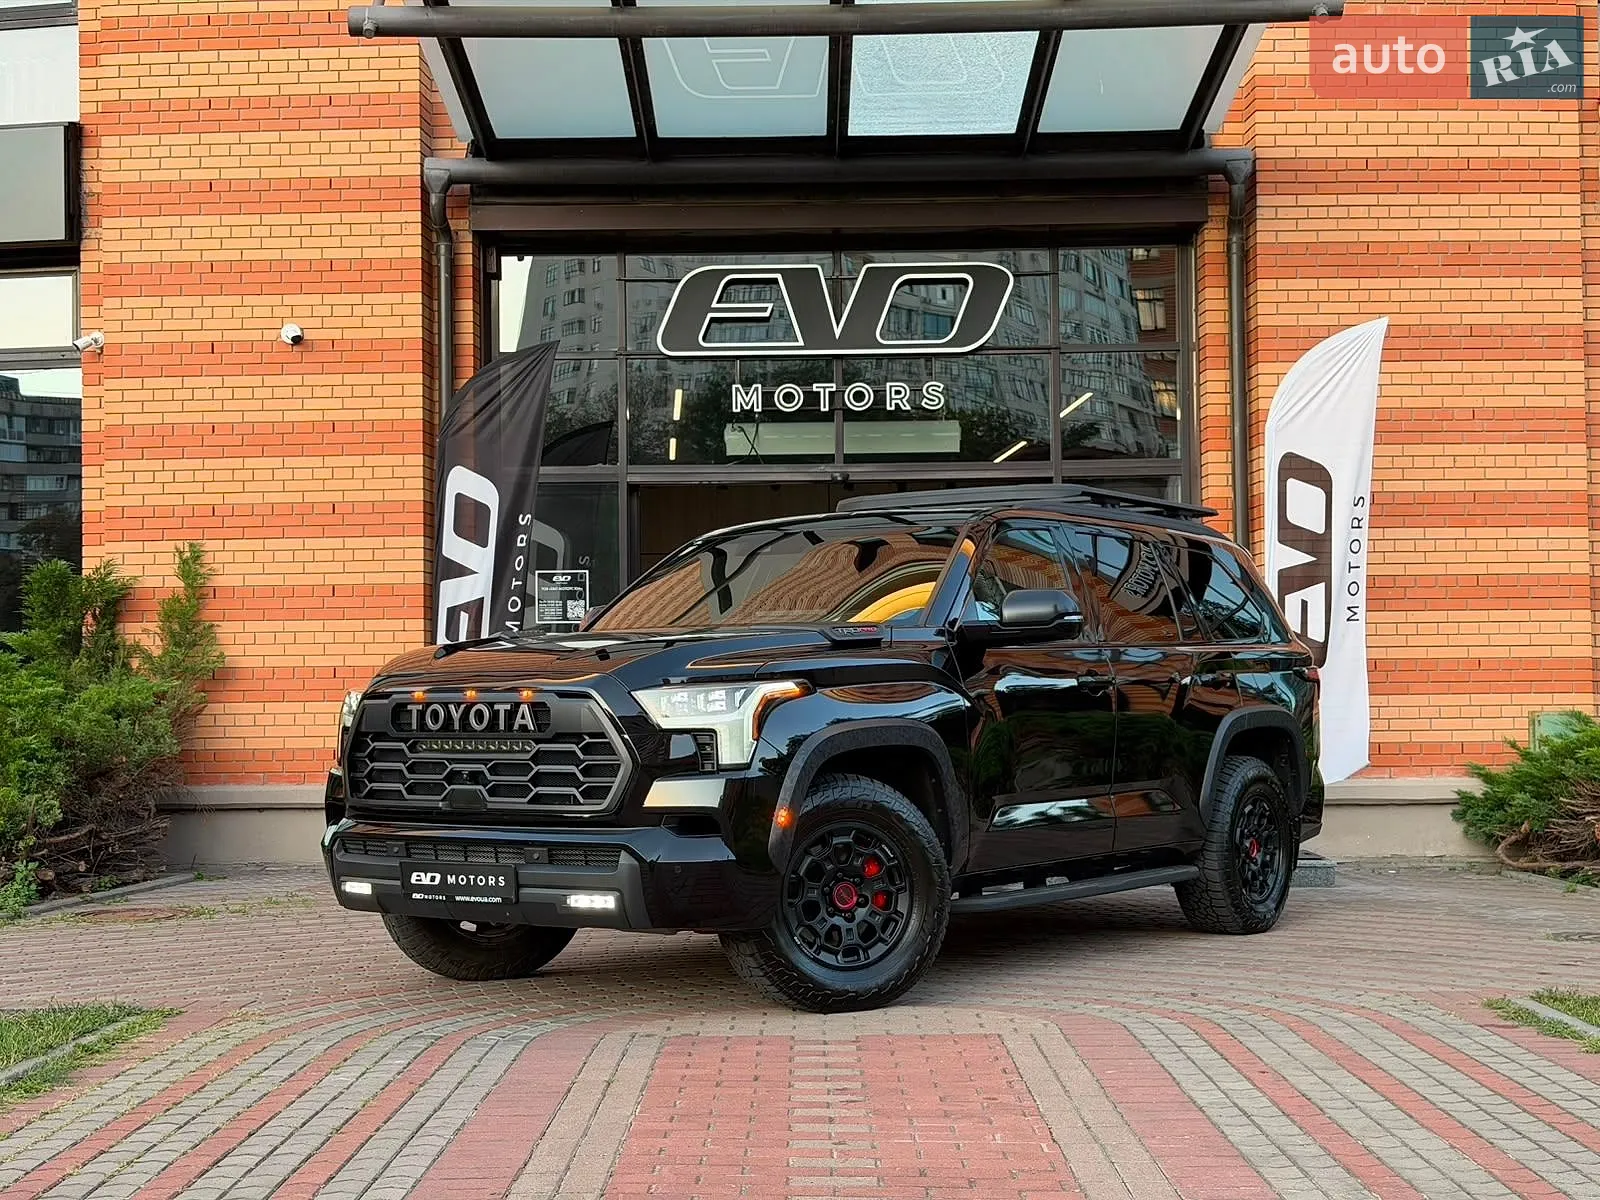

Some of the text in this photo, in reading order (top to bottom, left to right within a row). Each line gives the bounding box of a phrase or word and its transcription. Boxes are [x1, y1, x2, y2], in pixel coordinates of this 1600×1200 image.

[656, 262, 1014, 357] EVO
[731, 381, 946, 413] MOTORS
[436, 465, 500, 645] EVO
[505, 513, 532, 633] MOTORS
[1278, 451, 1333, 669] EVO
[1346, 495, 1365, 622] MOTORS
[406, 703, 535, 731] TOYOTA
[410, 872, 506, 887] EVO MOTORS
[454, 895, 502, 903] www.evoua.com
